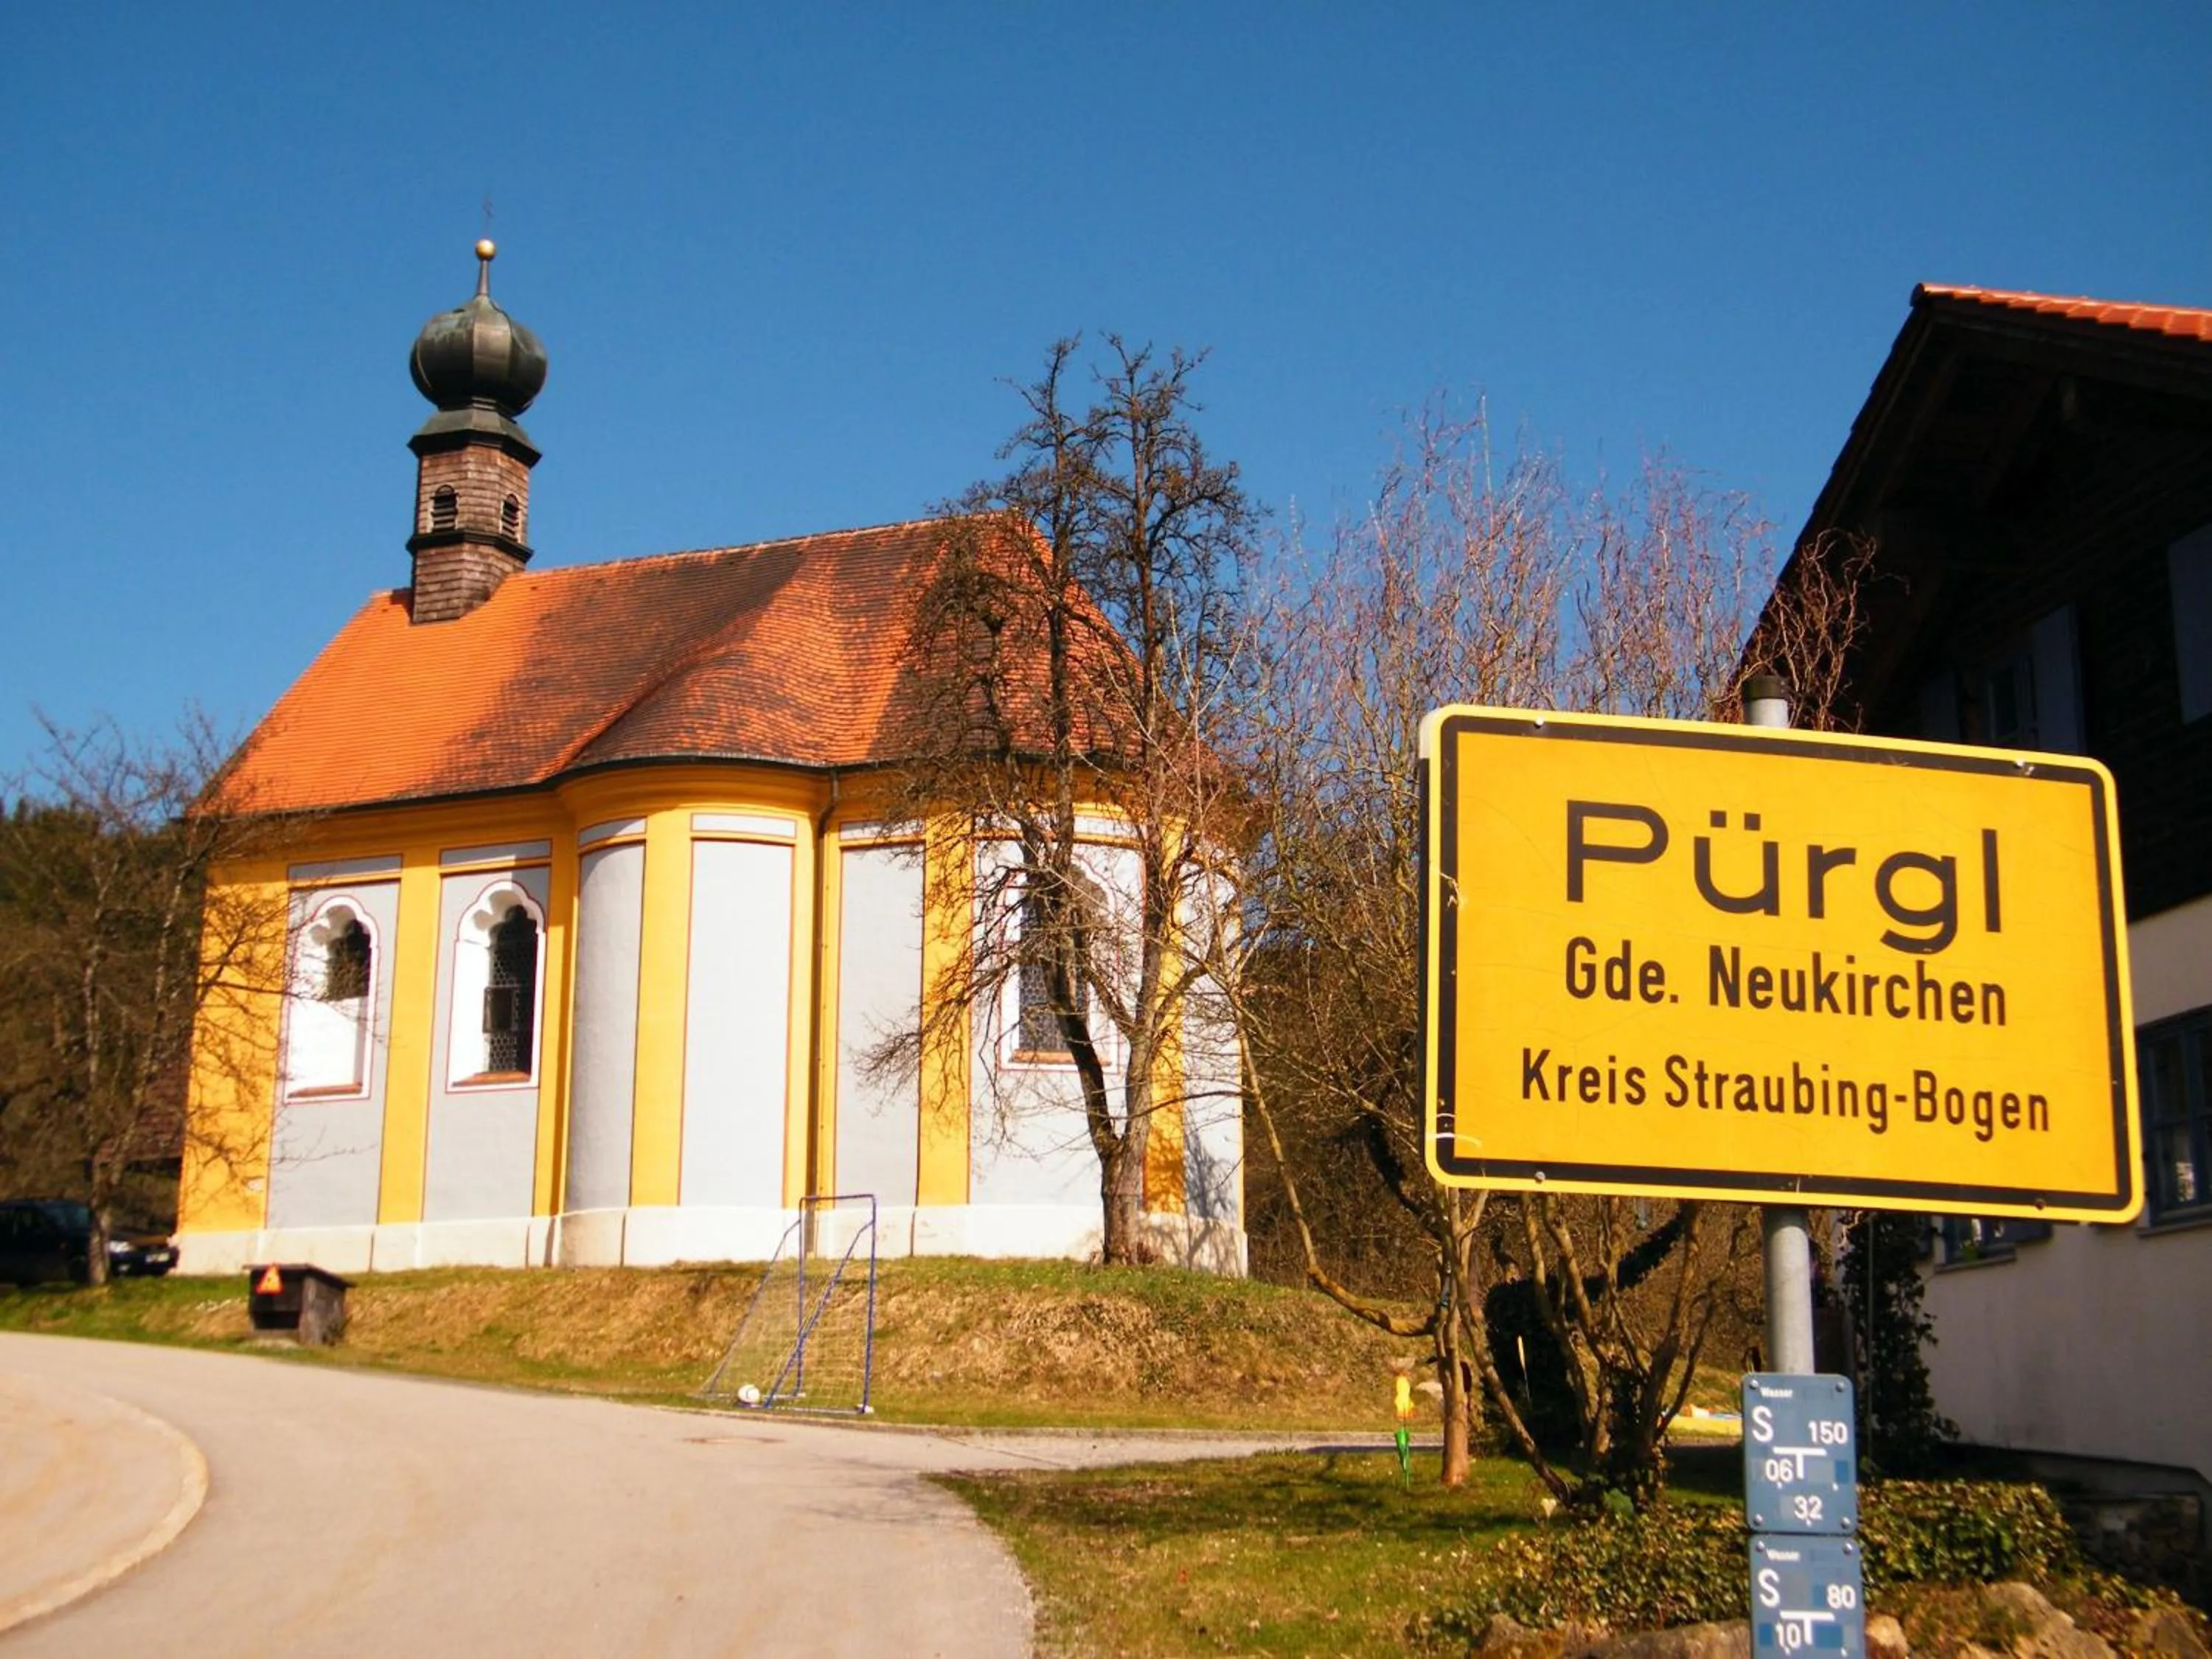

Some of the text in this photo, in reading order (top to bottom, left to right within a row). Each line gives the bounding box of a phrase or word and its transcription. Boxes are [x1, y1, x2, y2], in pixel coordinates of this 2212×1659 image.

[1566, 799, 2001, 956] Pürgl
[1565, 936, 2006, 1026] Gde. Neukirchen
[1522, 1047, 2049, 1143] Kreis Straubing-Bogen
[1752, 1405, 1848, 1445] S 150
[1760, 1387, 1793, 1398] Wasser
[1758, 1568, 1857, 1609] S 80
